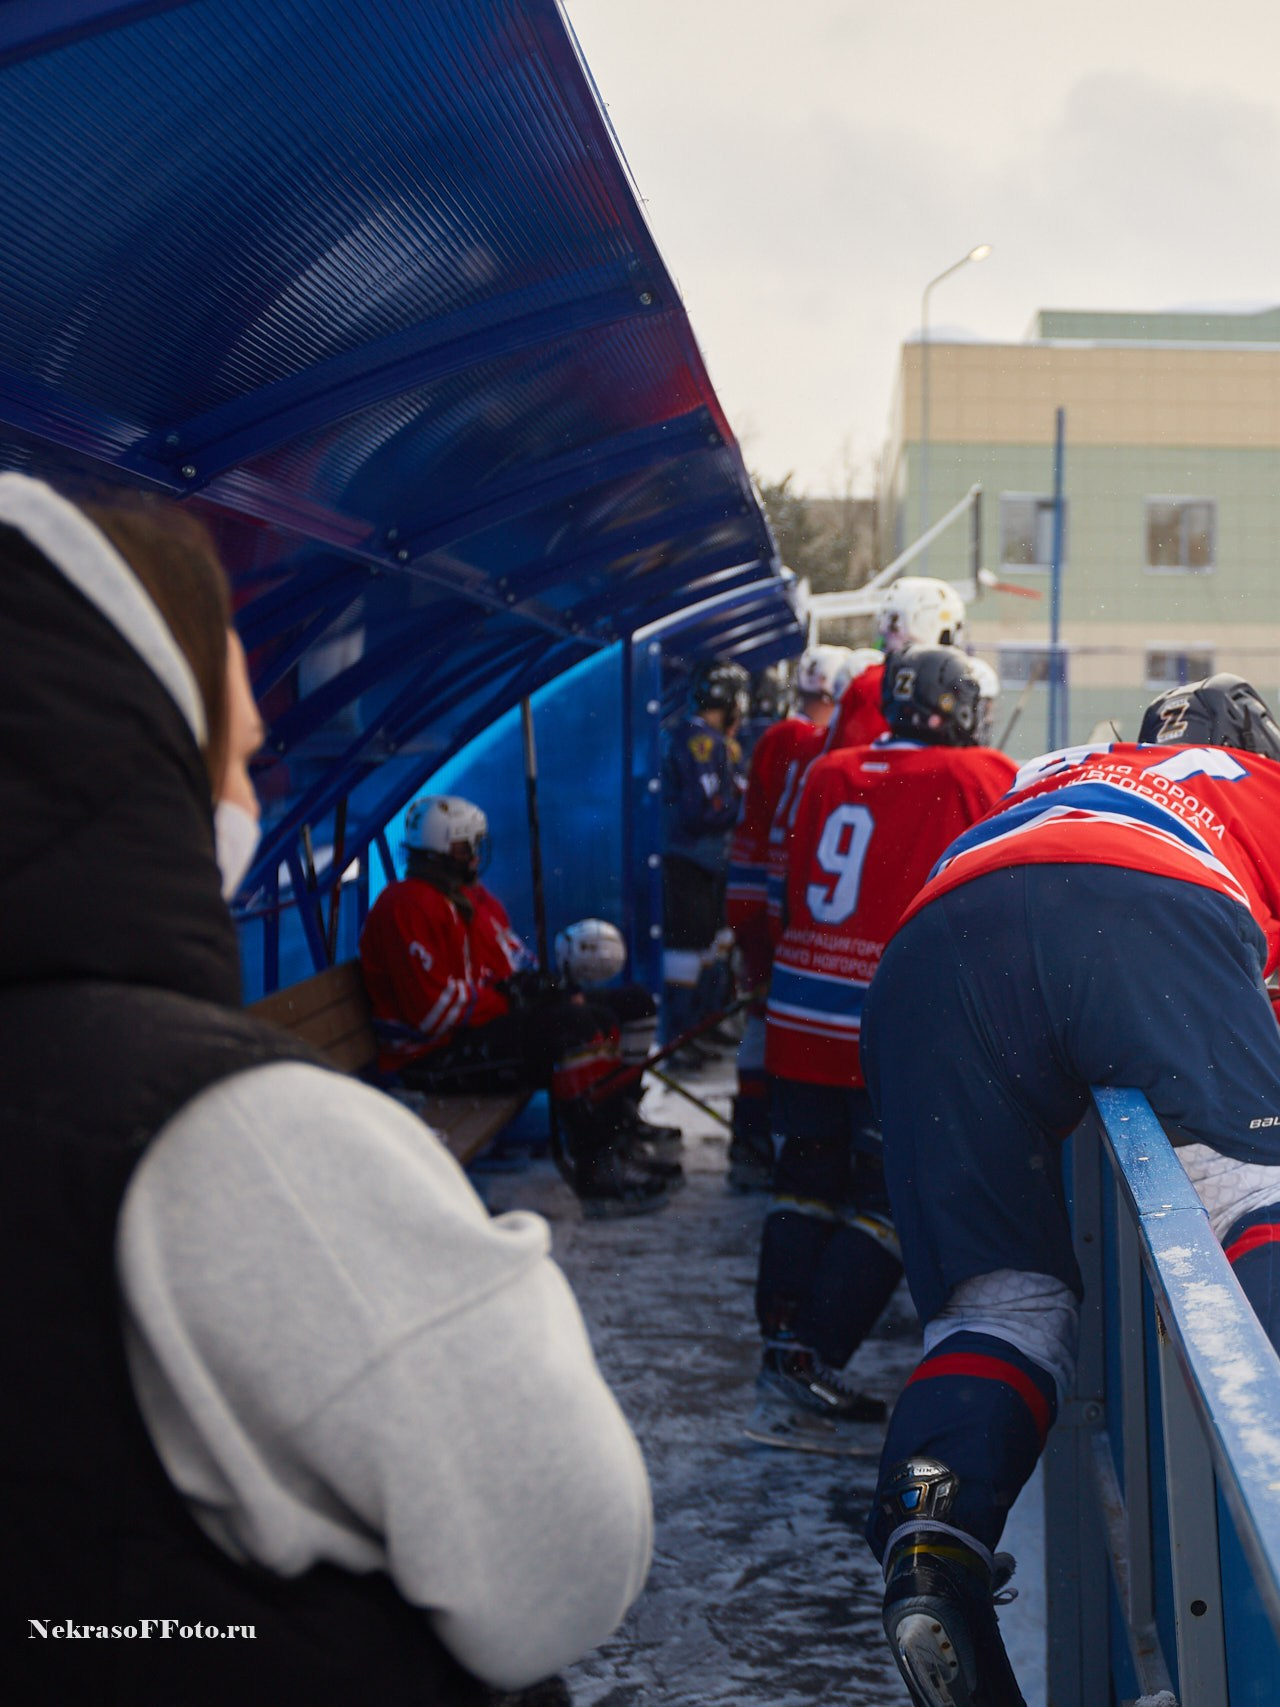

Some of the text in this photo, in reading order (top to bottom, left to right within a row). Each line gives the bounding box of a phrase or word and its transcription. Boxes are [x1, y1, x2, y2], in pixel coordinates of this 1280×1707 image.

[1059, 769, 1201, 829] ВГОРОДА
[1138, 770, 1225, 841] ГОРОДА
[806, 803, 875, 925] 9
[409, 940, 433, 972] 3
